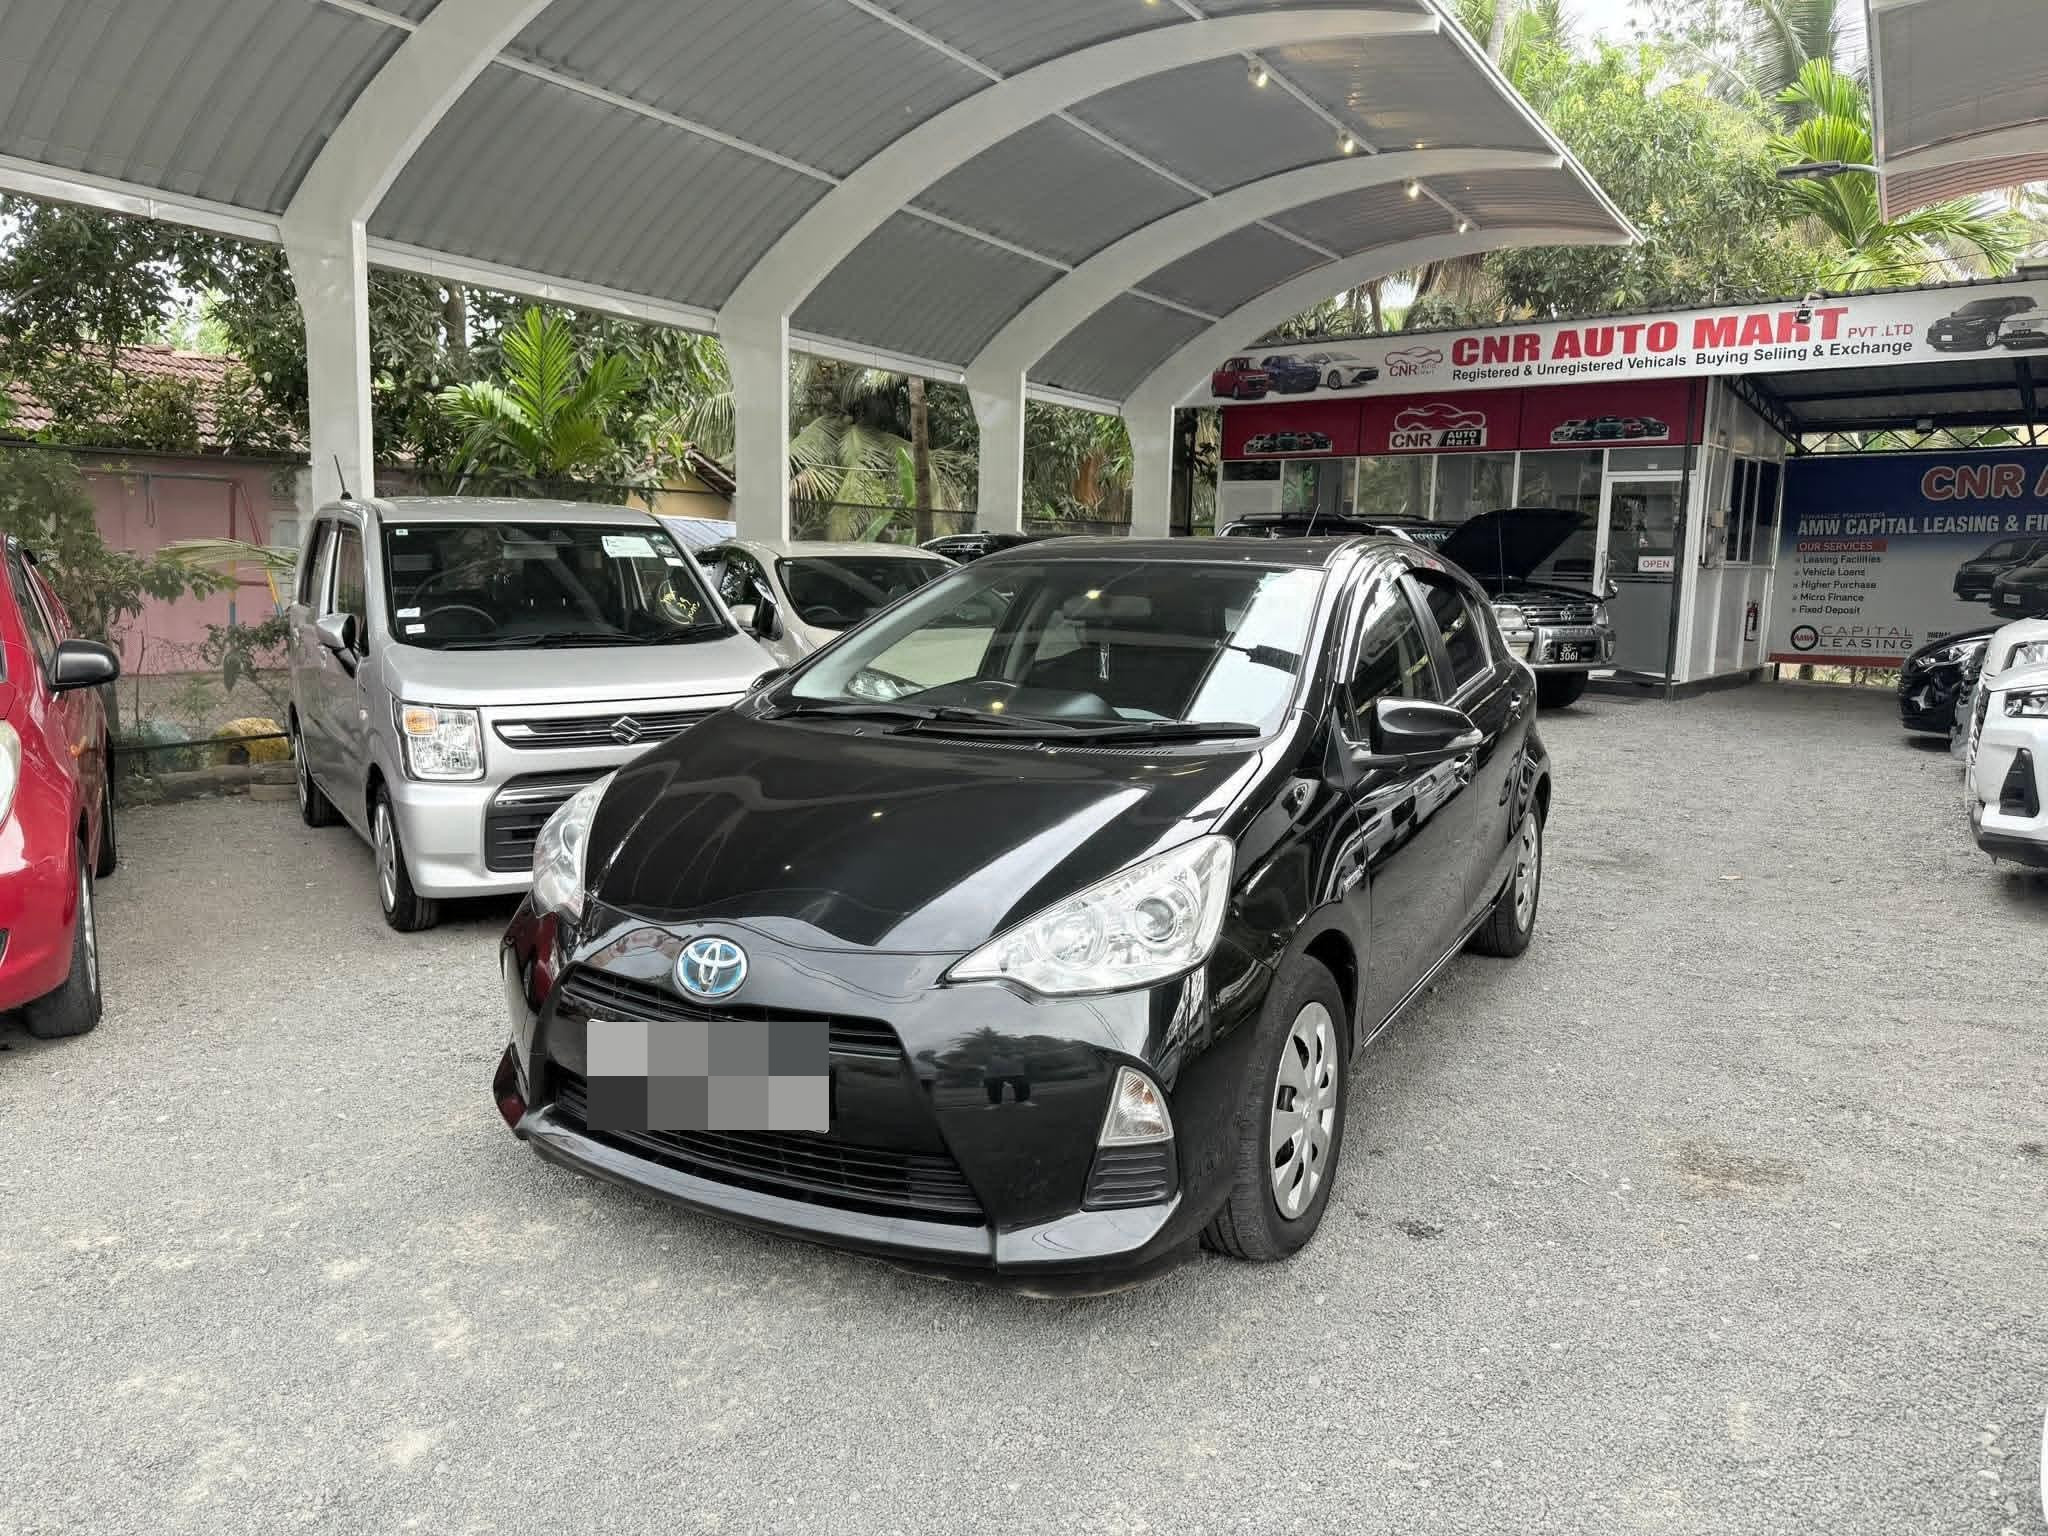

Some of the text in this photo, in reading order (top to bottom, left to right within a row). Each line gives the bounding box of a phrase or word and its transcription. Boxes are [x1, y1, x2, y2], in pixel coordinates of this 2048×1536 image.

[1451, 333, 1541, 367] CNR
[1552, 321, 1678, 359] AUTO
[1693, 307, 1848, 349] MART
[1848, 326, 1878, 339] PVT
[1452, 364, 1520, 383] Registered
[1523, 362, 1533, 376] &
[1537, 356, 1623, 377] Unregistered
[1627, 354, 1686, 370] Vehicals
[1696, 346, 1748, 367] Buying
[1812, 344, 1824, 357] &
[1830, 341, 1913, 356] Exchange
[1390, 364, 1417, 376] CNR
[1391, 432, 1432, 448] CNR
[1447, 430, 1477, 439] AUTO
[1921, 464, 2025, 501] CNR
[1798, 519, 1840, 536] AMW
[1846, 517, 1918, 535] CAPITAL
[1923, 515, 1999, 533] LEASING
[2004, 515, 2019, 532] &
[1799, 542, 1873, 551] OUR SERVICES
[1642, 560, 1670, 568] OPEN
[1803, 555, 1838, 565] Leasing
[1802, 567, 1865, 576] Vehicle Loans
[1801, 580, 1877, 590] Higher Purchase
[1800, 592, 1864, 601] Micro Finance
[1799, 605, 1861, 616] Fixed Deposit
[1820, 625, 1913, 637] CAPITAL
[1819, 638, 1913, 650] LEASING
[1560, 651, 1579, 661] 3061
